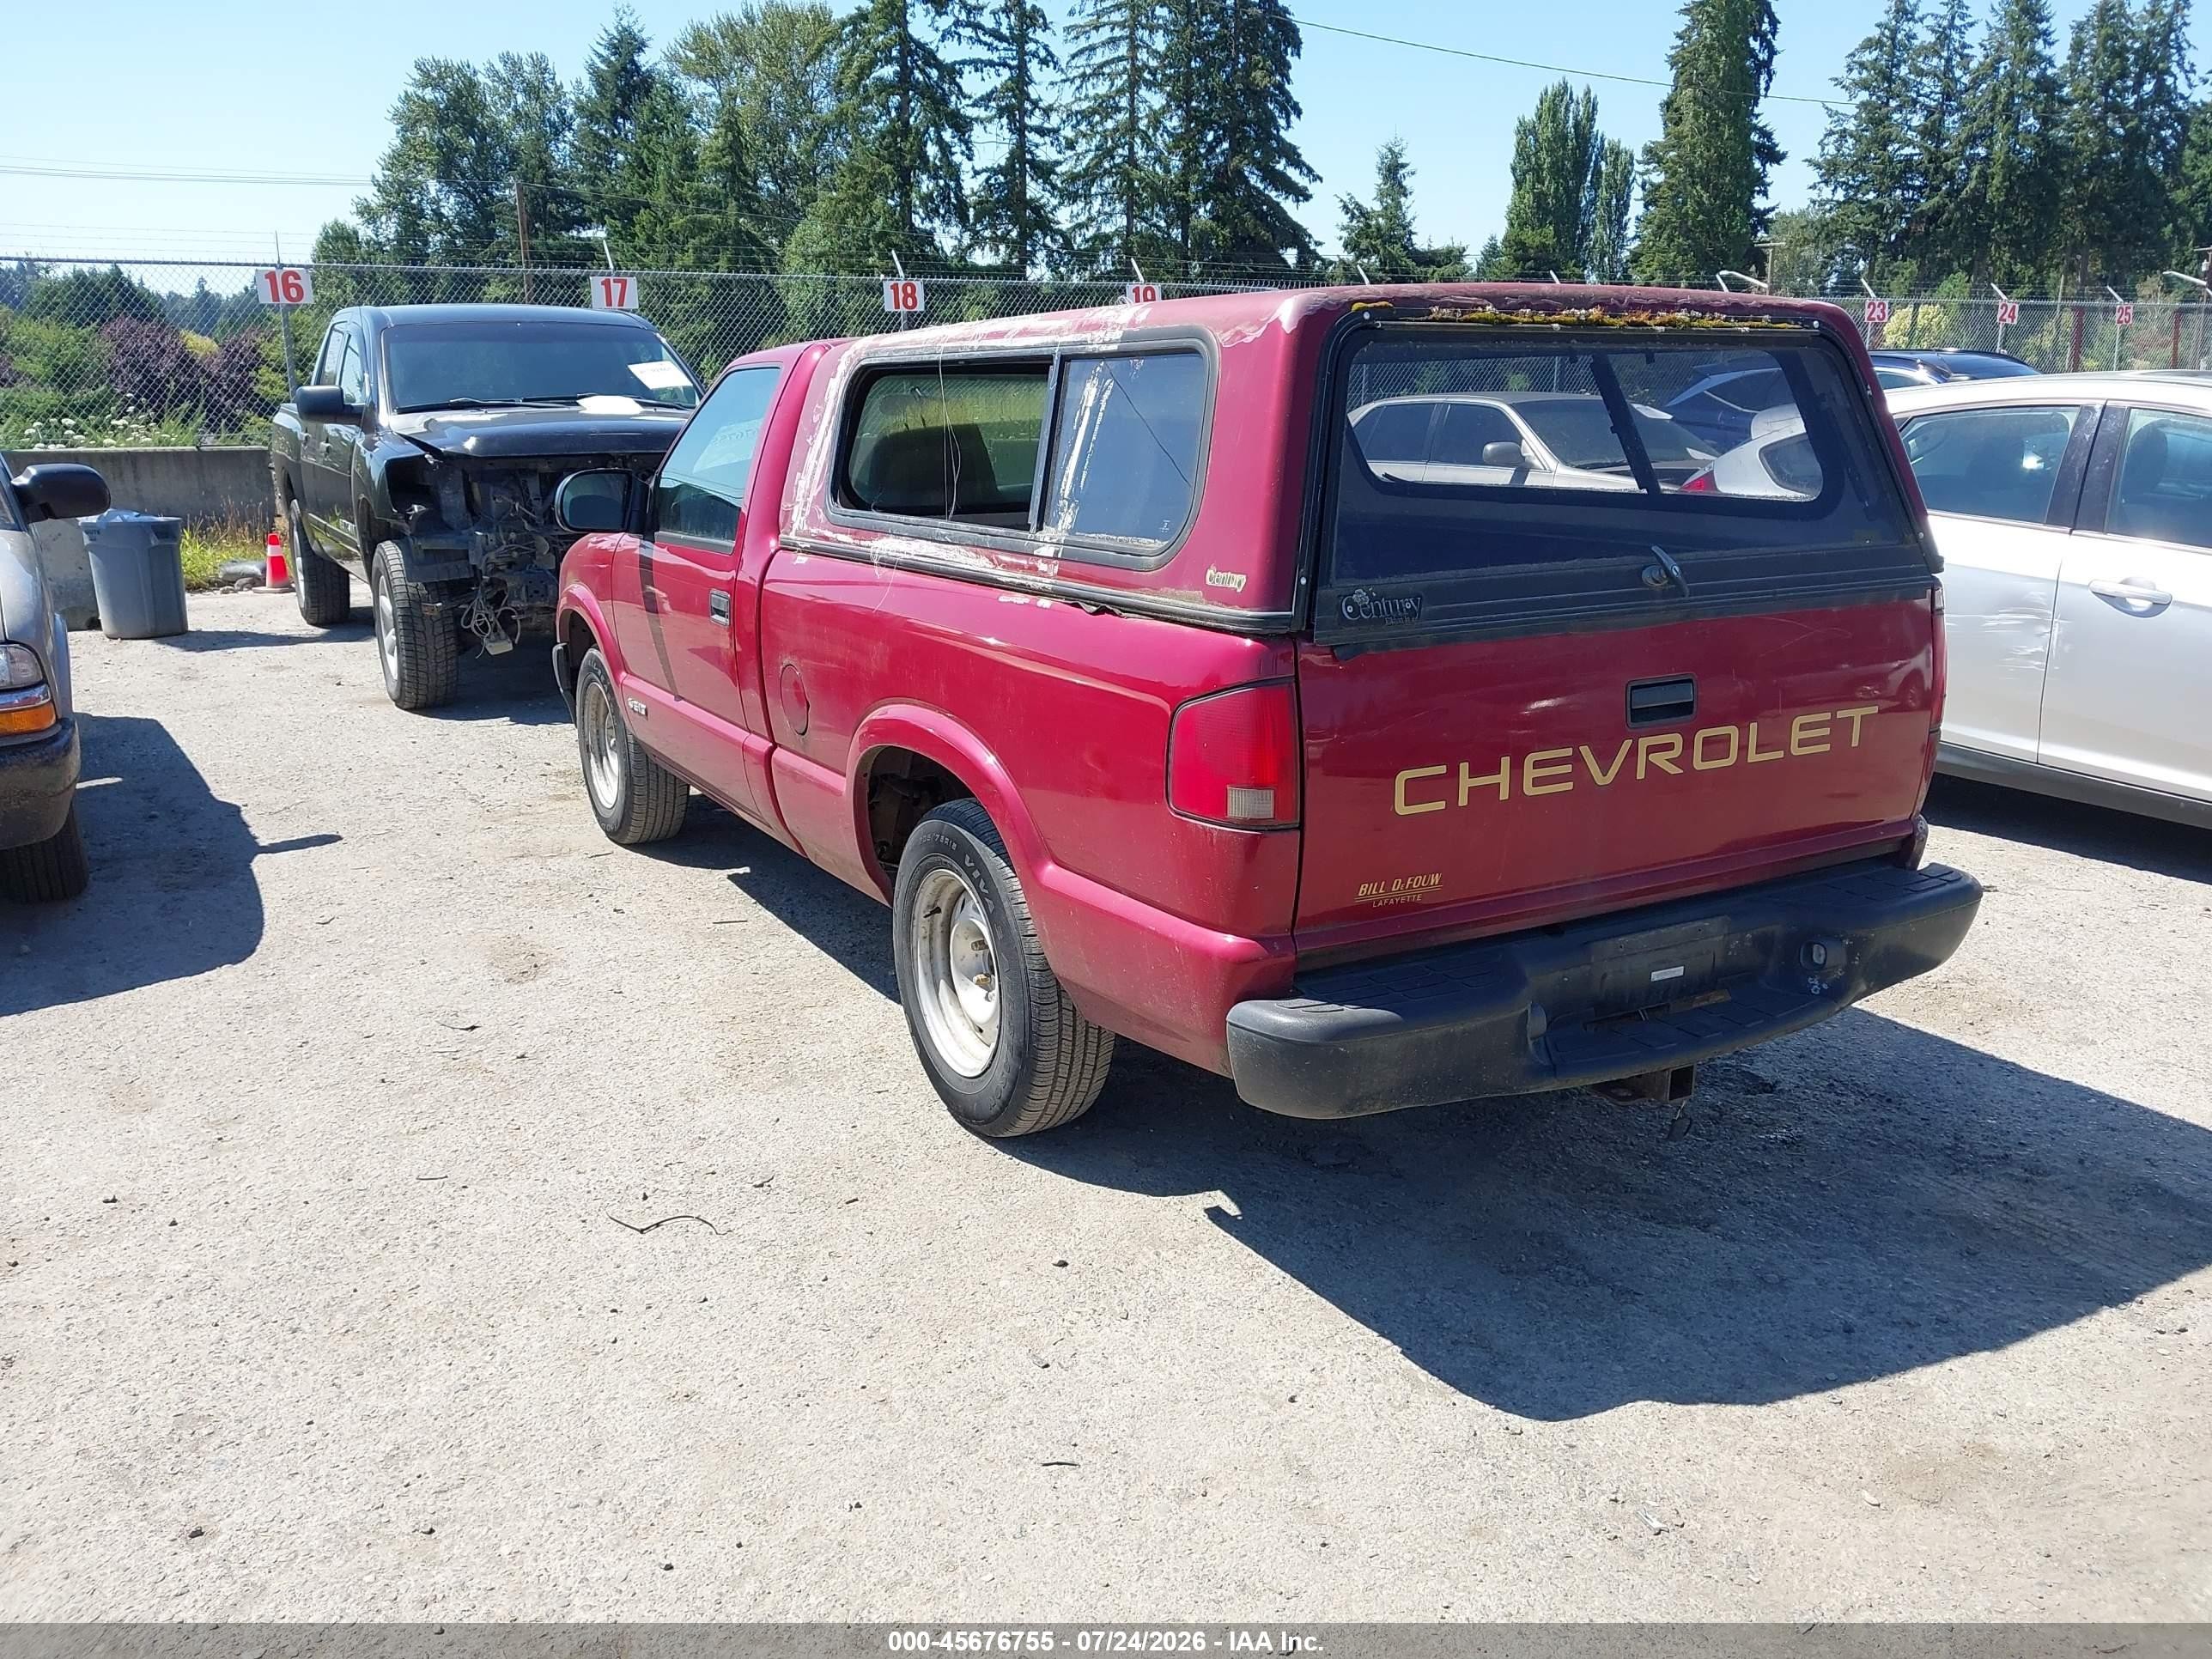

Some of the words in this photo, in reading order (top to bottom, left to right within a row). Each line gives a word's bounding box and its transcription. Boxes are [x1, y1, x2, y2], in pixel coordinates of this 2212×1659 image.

[264, 270, 304, 303] 16
[600, 277, 628, 307] 17
[890, 282, 918, 311] 18
[1867, 301, 1887, 321] 23
[1998, 303, 2017, 324] 24
[2116, 306, 2132, 325] 25
[1341, 592, 1421, 620] Century
[1394, 705, 1881, 816] CHEVROLET
[964, 854, 995, 915] VIVA
[1358, 881, 1386, 896] BILL
[1373, 894, 1422, 908] LAFAYETTE
